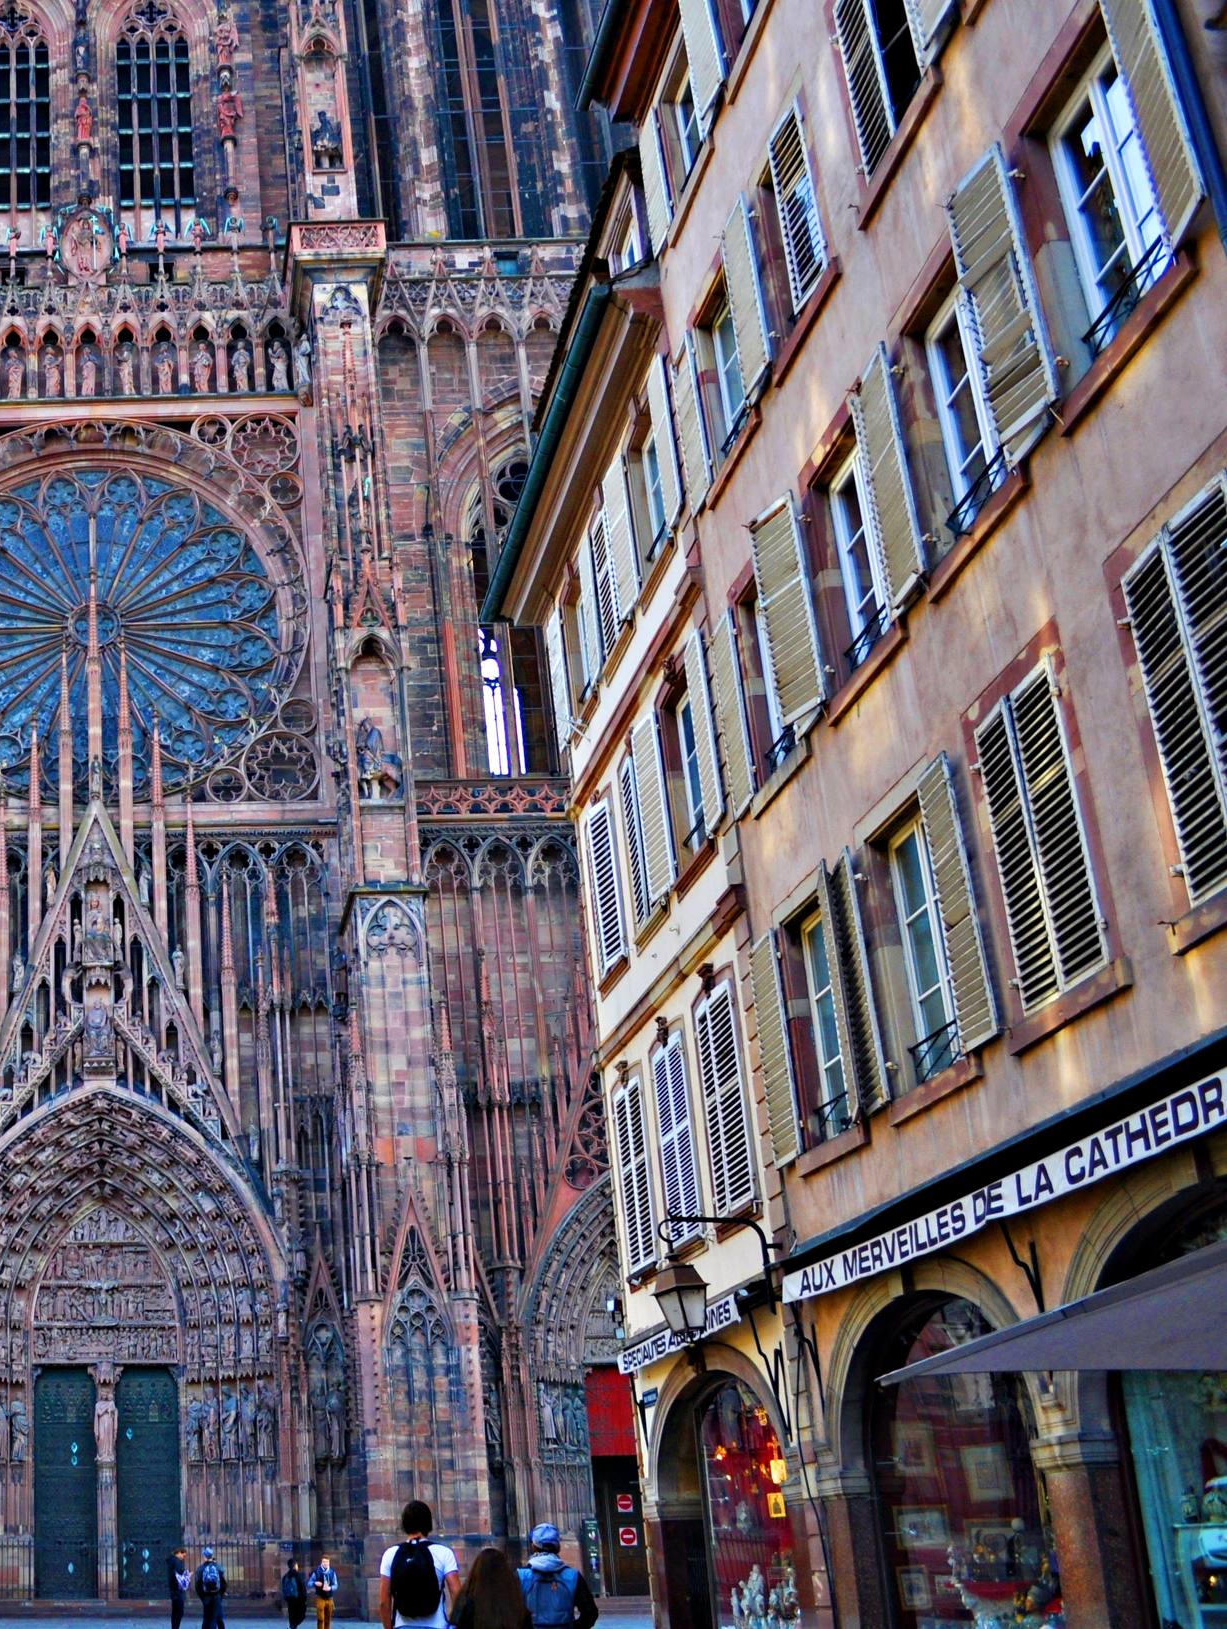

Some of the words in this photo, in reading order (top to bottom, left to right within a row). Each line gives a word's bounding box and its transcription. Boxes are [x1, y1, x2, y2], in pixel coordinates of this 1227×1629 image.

[798, 1258, 837, 1297] AUX
[841, 1201, 967, 1282] MERVEILLES
[971, 1180, 1005, 1226] DE
[1015, 1162, 1054, 1208] LA
[1064, 1076, 1226, 1185] CATHEDR
